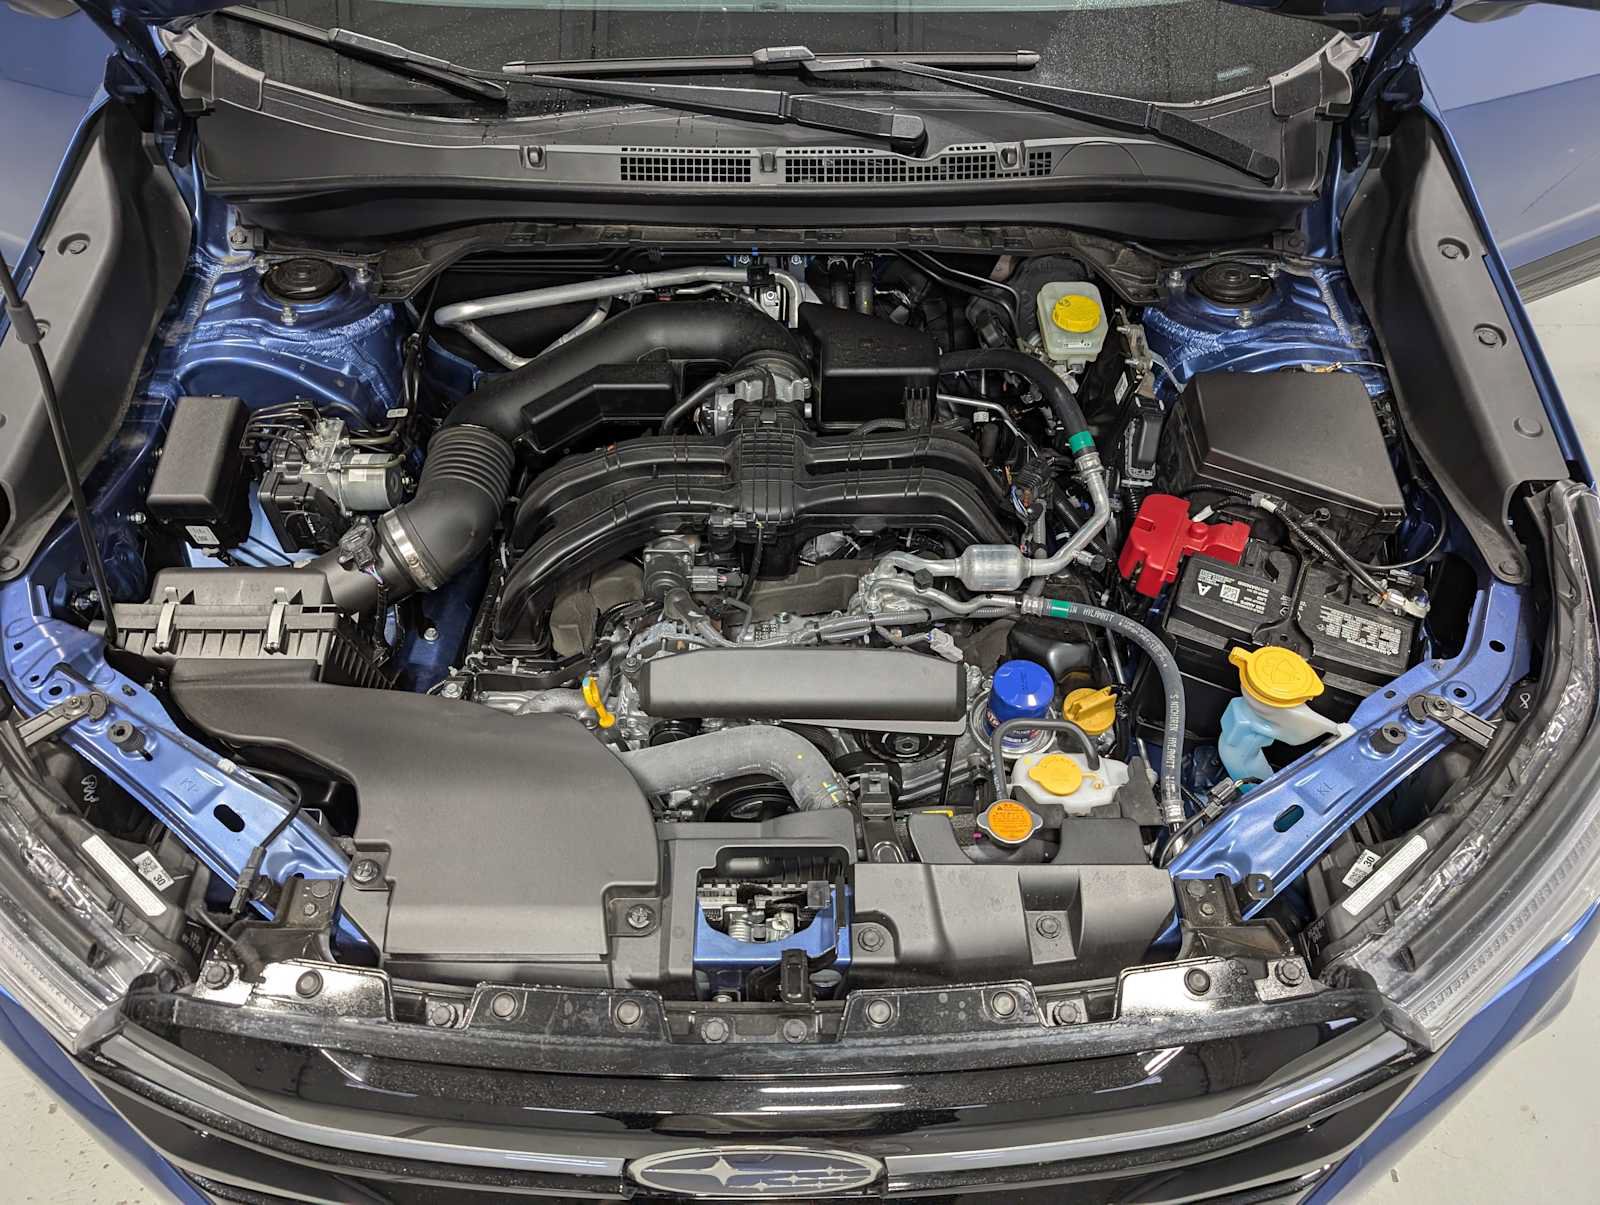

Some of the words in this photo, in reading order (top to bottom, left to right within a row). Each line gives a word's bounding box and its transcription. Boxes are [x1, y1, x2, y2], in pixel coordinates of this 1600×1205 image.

[1197, 582, 1212, 596] A
[1363, 856, 1375, 867] 30
[153, 873, 166, 886] 30
